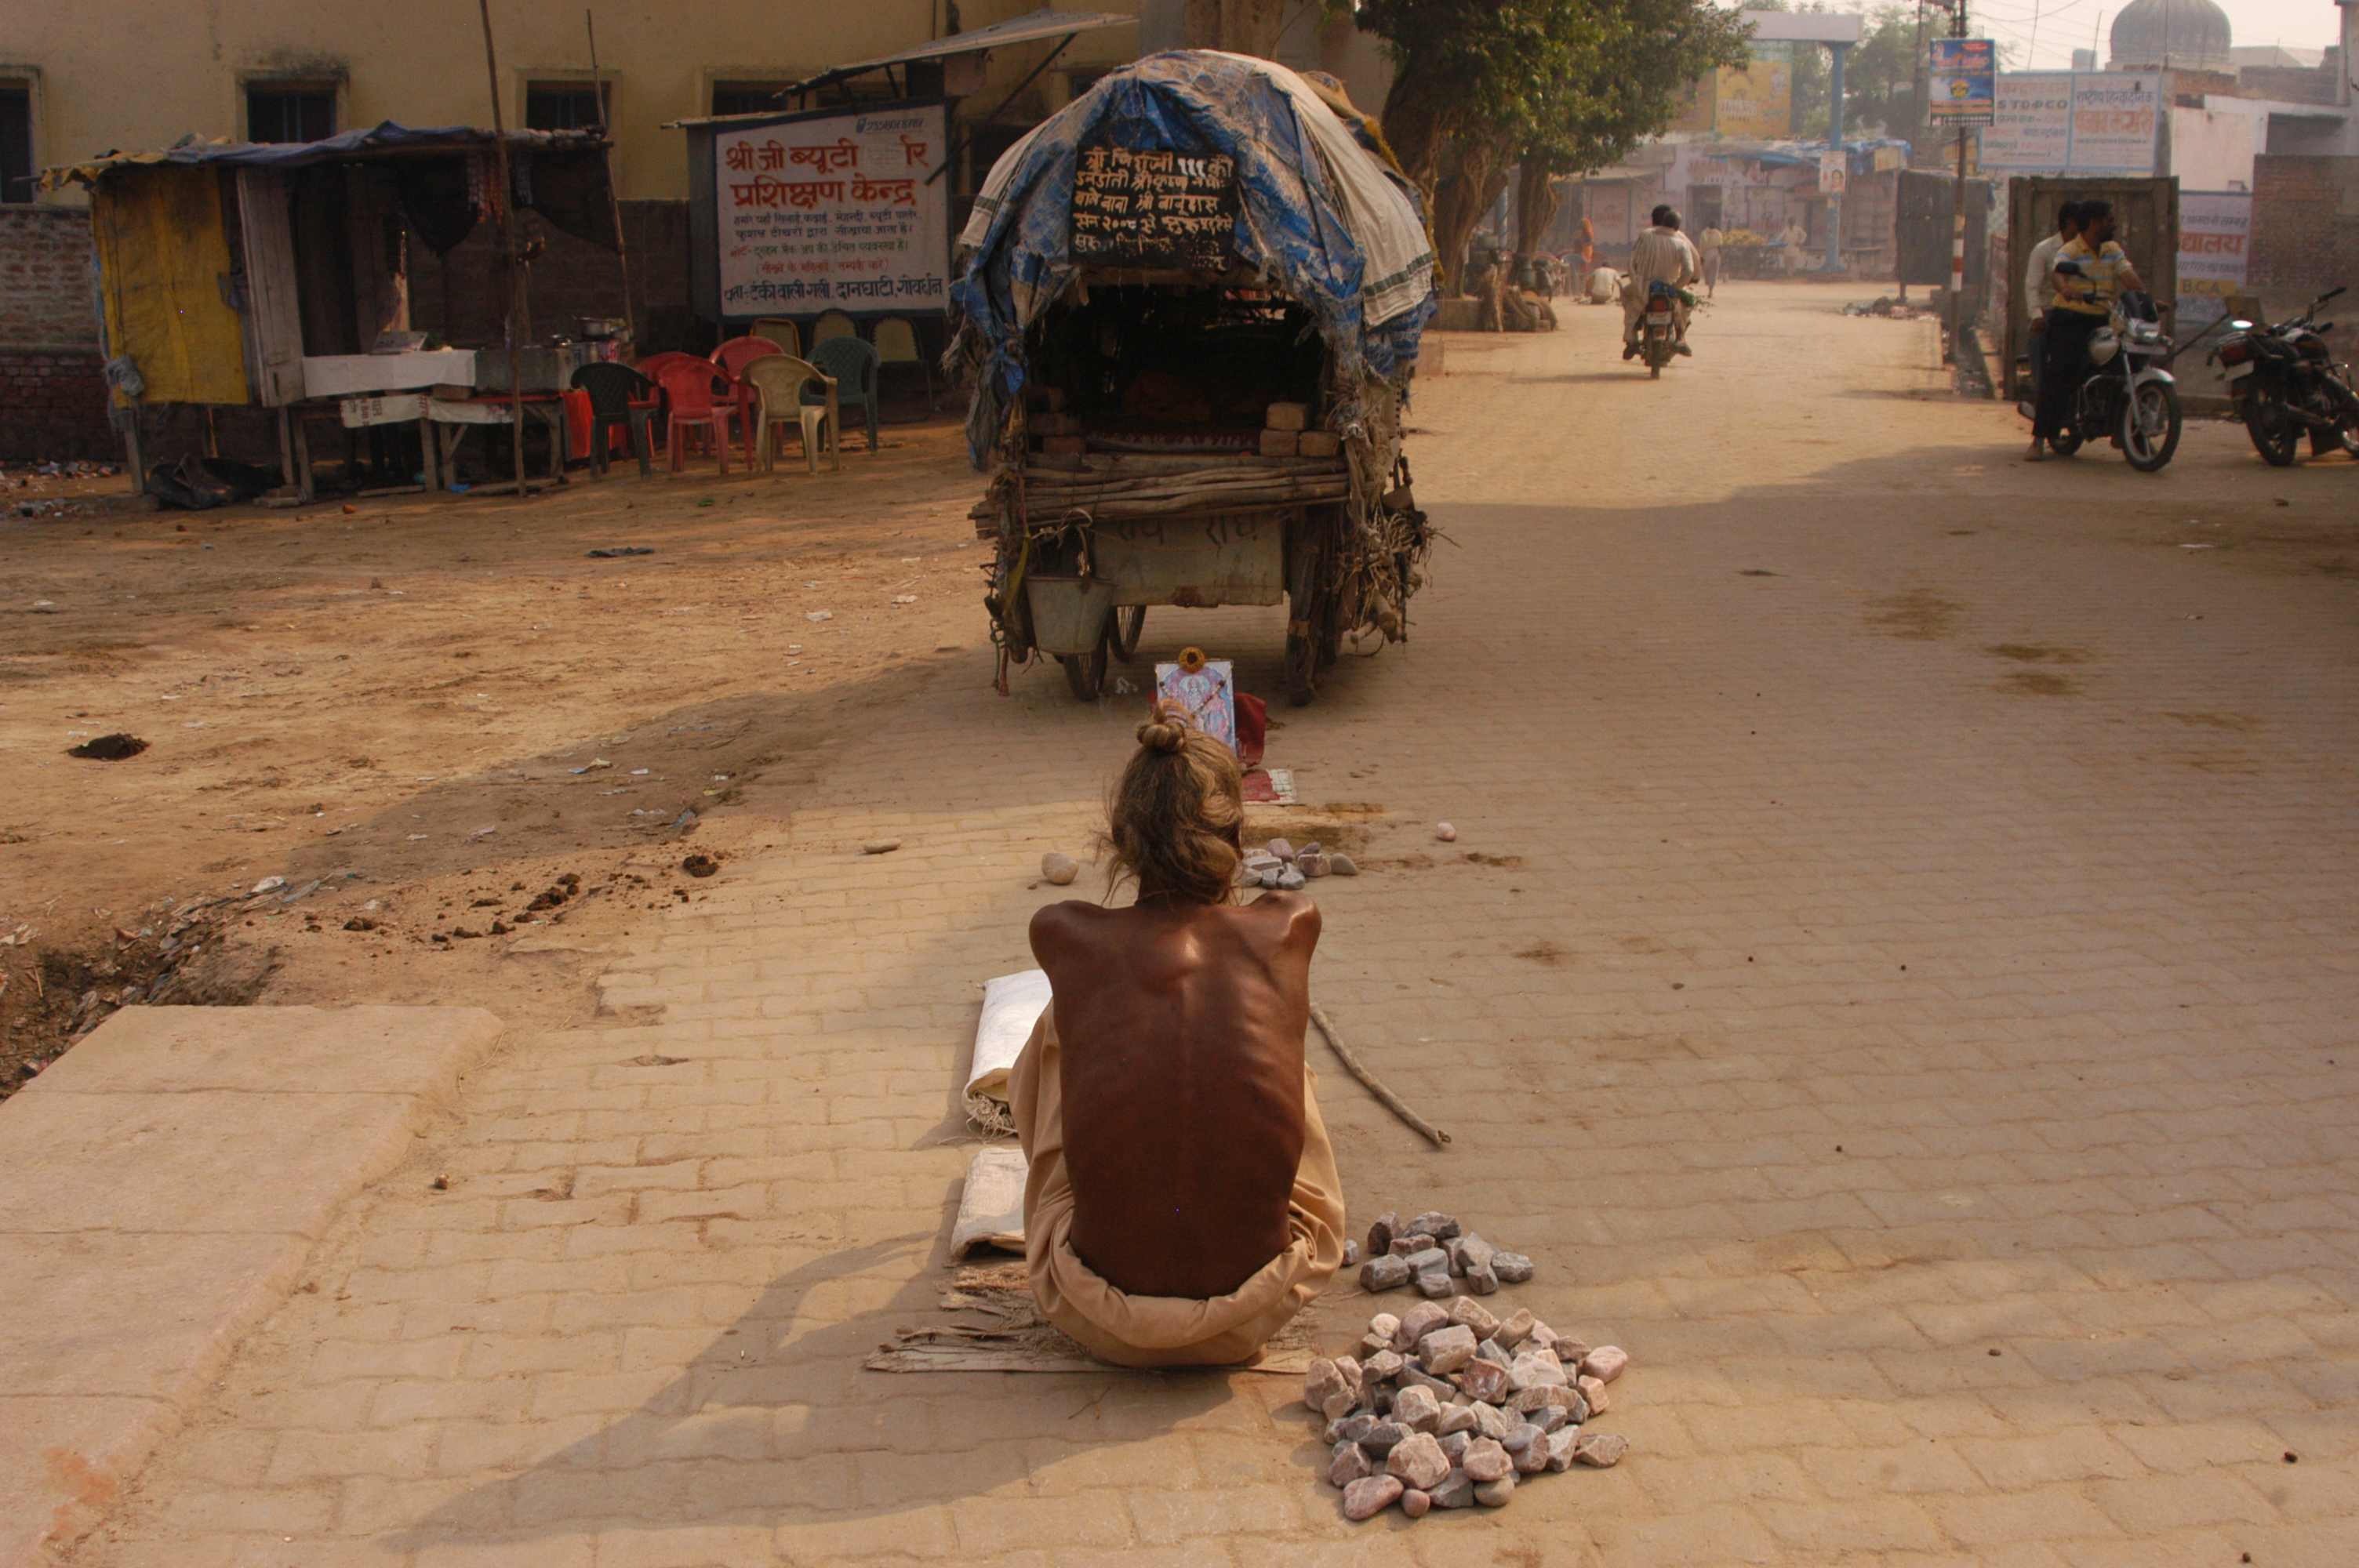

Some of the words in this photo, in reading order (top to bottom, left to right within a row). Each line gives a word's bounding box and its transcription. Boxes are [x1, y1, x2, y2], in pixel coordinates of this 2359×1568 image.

[725, 140, 753, 172] श्री
[757, 138, 785, 171] जी
[789, 137, 859, 175] ब्यूटी
[1085, 146, 1109, 170] श्री
[729, 174, 846, 210] प्रशिक्षण
[850, 172, 918, 207] केन्द्र
